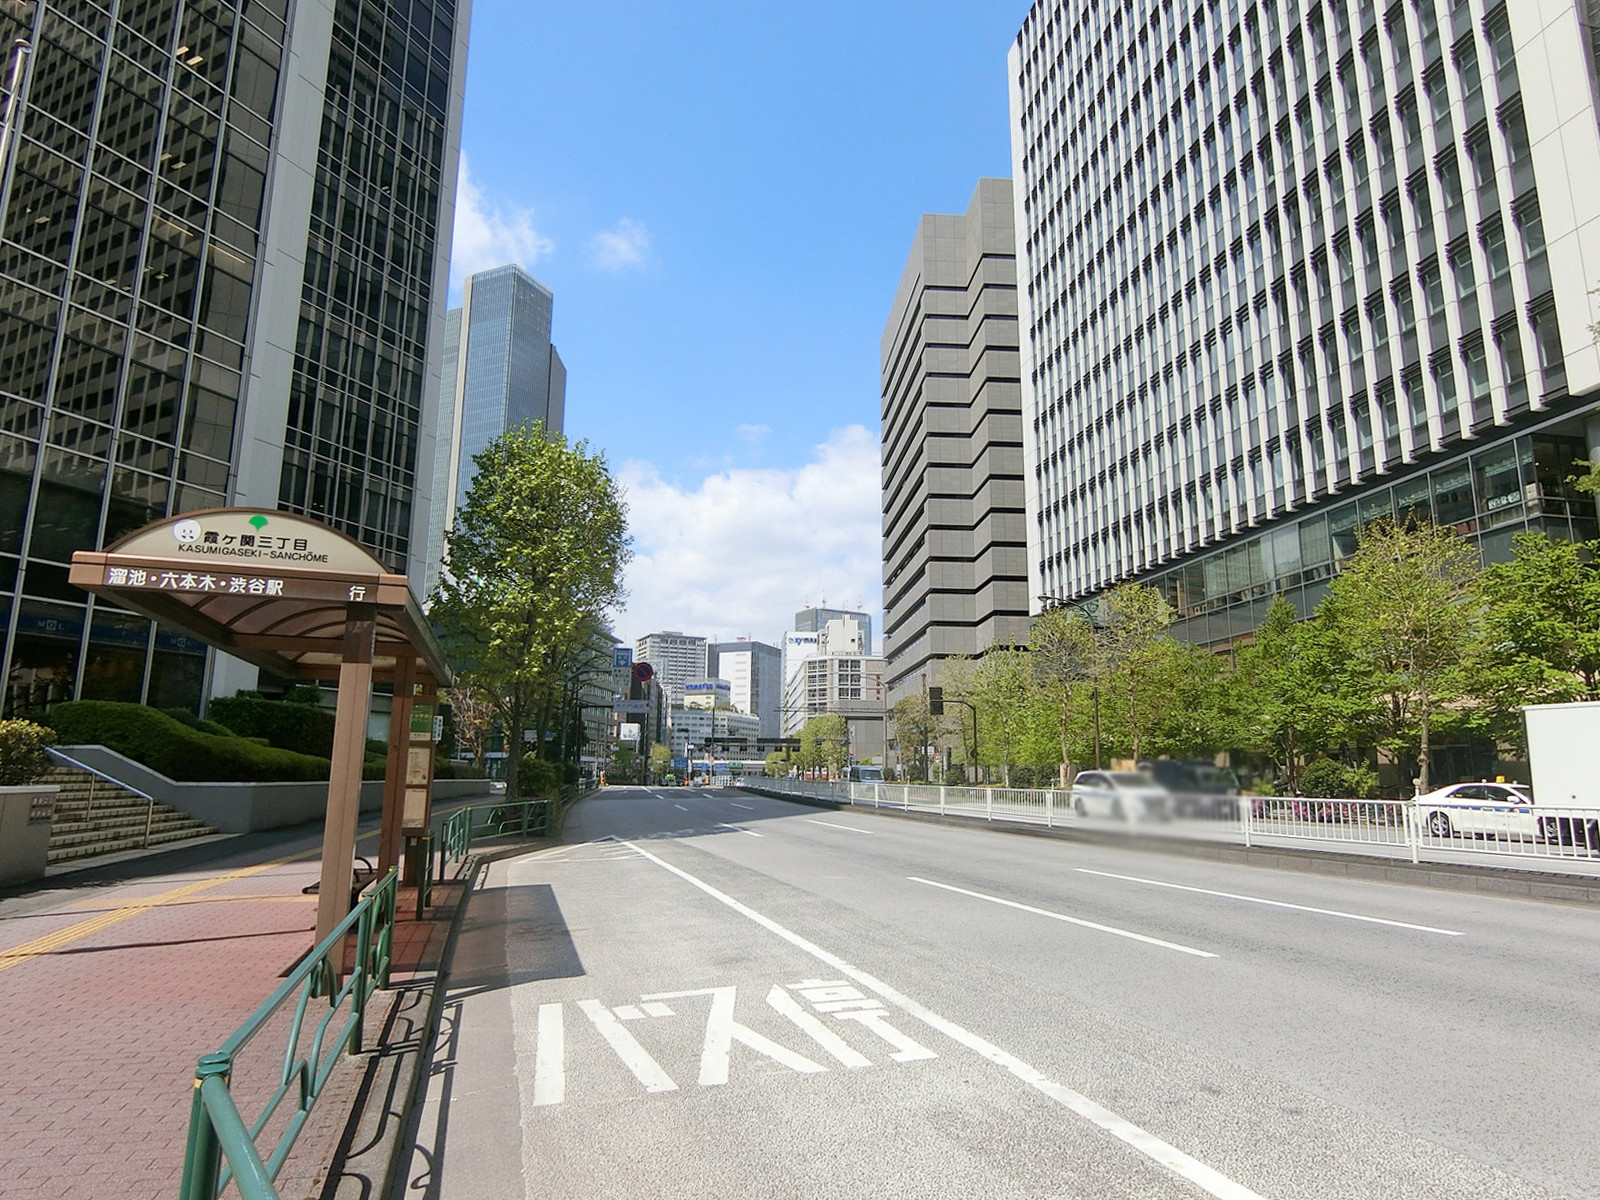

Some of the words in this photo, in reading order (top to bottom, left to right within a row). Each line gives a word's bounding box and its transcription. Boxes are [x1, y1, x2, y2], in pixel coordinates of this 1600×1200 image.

[349, 585, 366, 601] 行
[533, 979, 940, 1107] バス停
